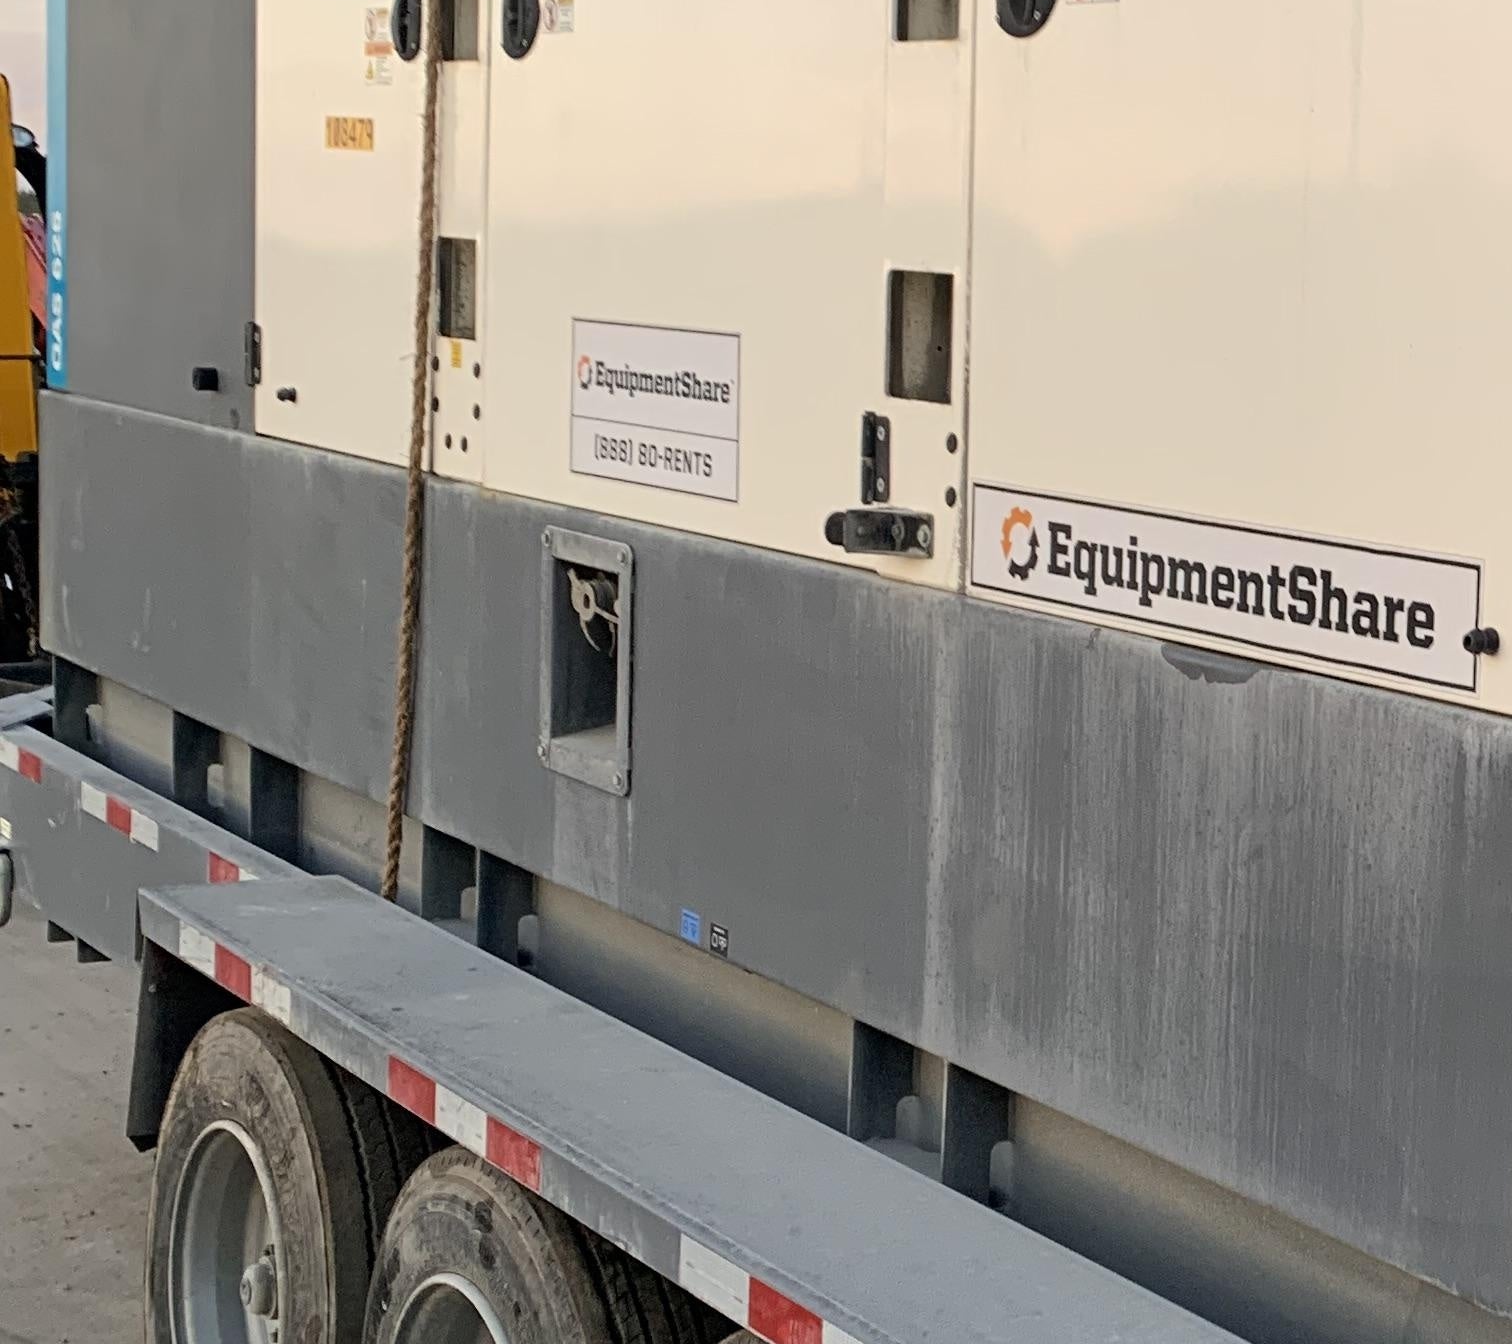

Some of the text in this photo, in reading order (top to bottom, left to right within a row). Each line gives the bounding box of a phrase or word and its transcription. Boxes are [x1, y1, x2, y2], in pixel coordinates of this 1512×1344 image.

[595, 360, 731, 403] EquipmentShare
[638, 442, 713, 478] 80-RENTS
[1047, 520, 1436, 650] EquipmentShare
